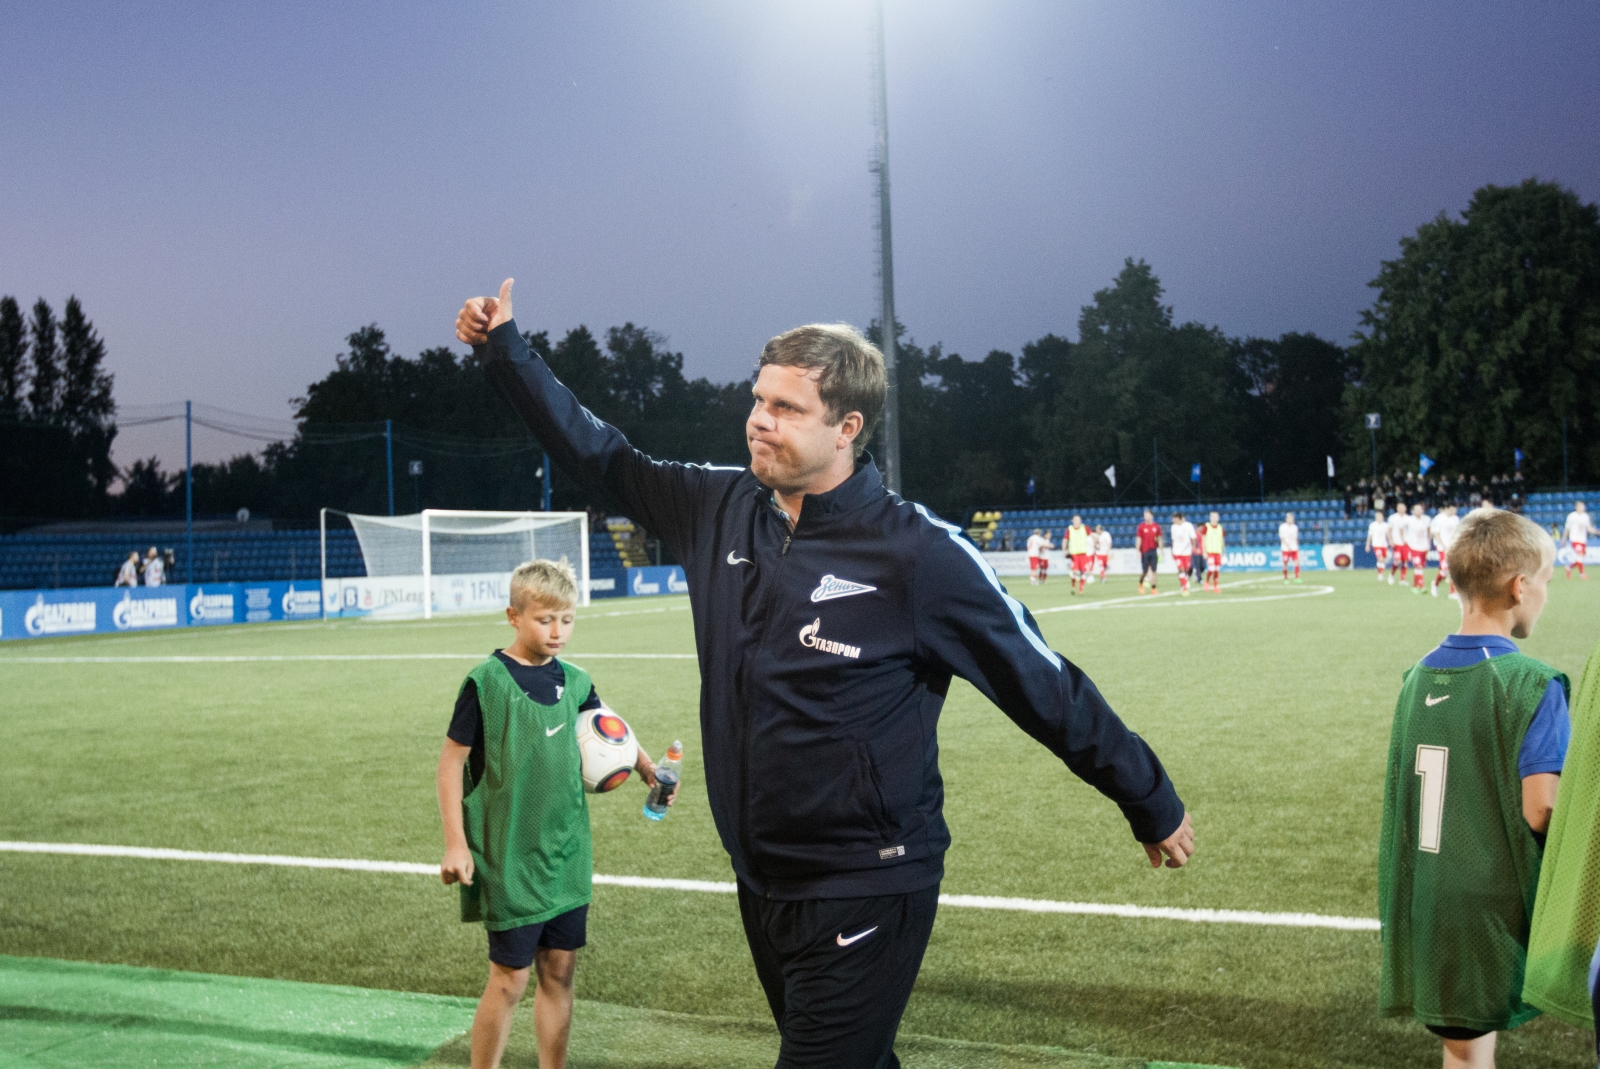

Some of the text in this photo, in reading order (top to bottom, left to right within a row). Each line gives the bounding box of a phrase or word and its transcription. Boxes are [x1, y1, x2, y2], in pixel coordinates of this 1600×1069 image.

[1229, 553, 1266, 566] JAKO
[815, 638, 861, 659] ГАЗПРОМ
[1415, 744, 1448, 854] 1
